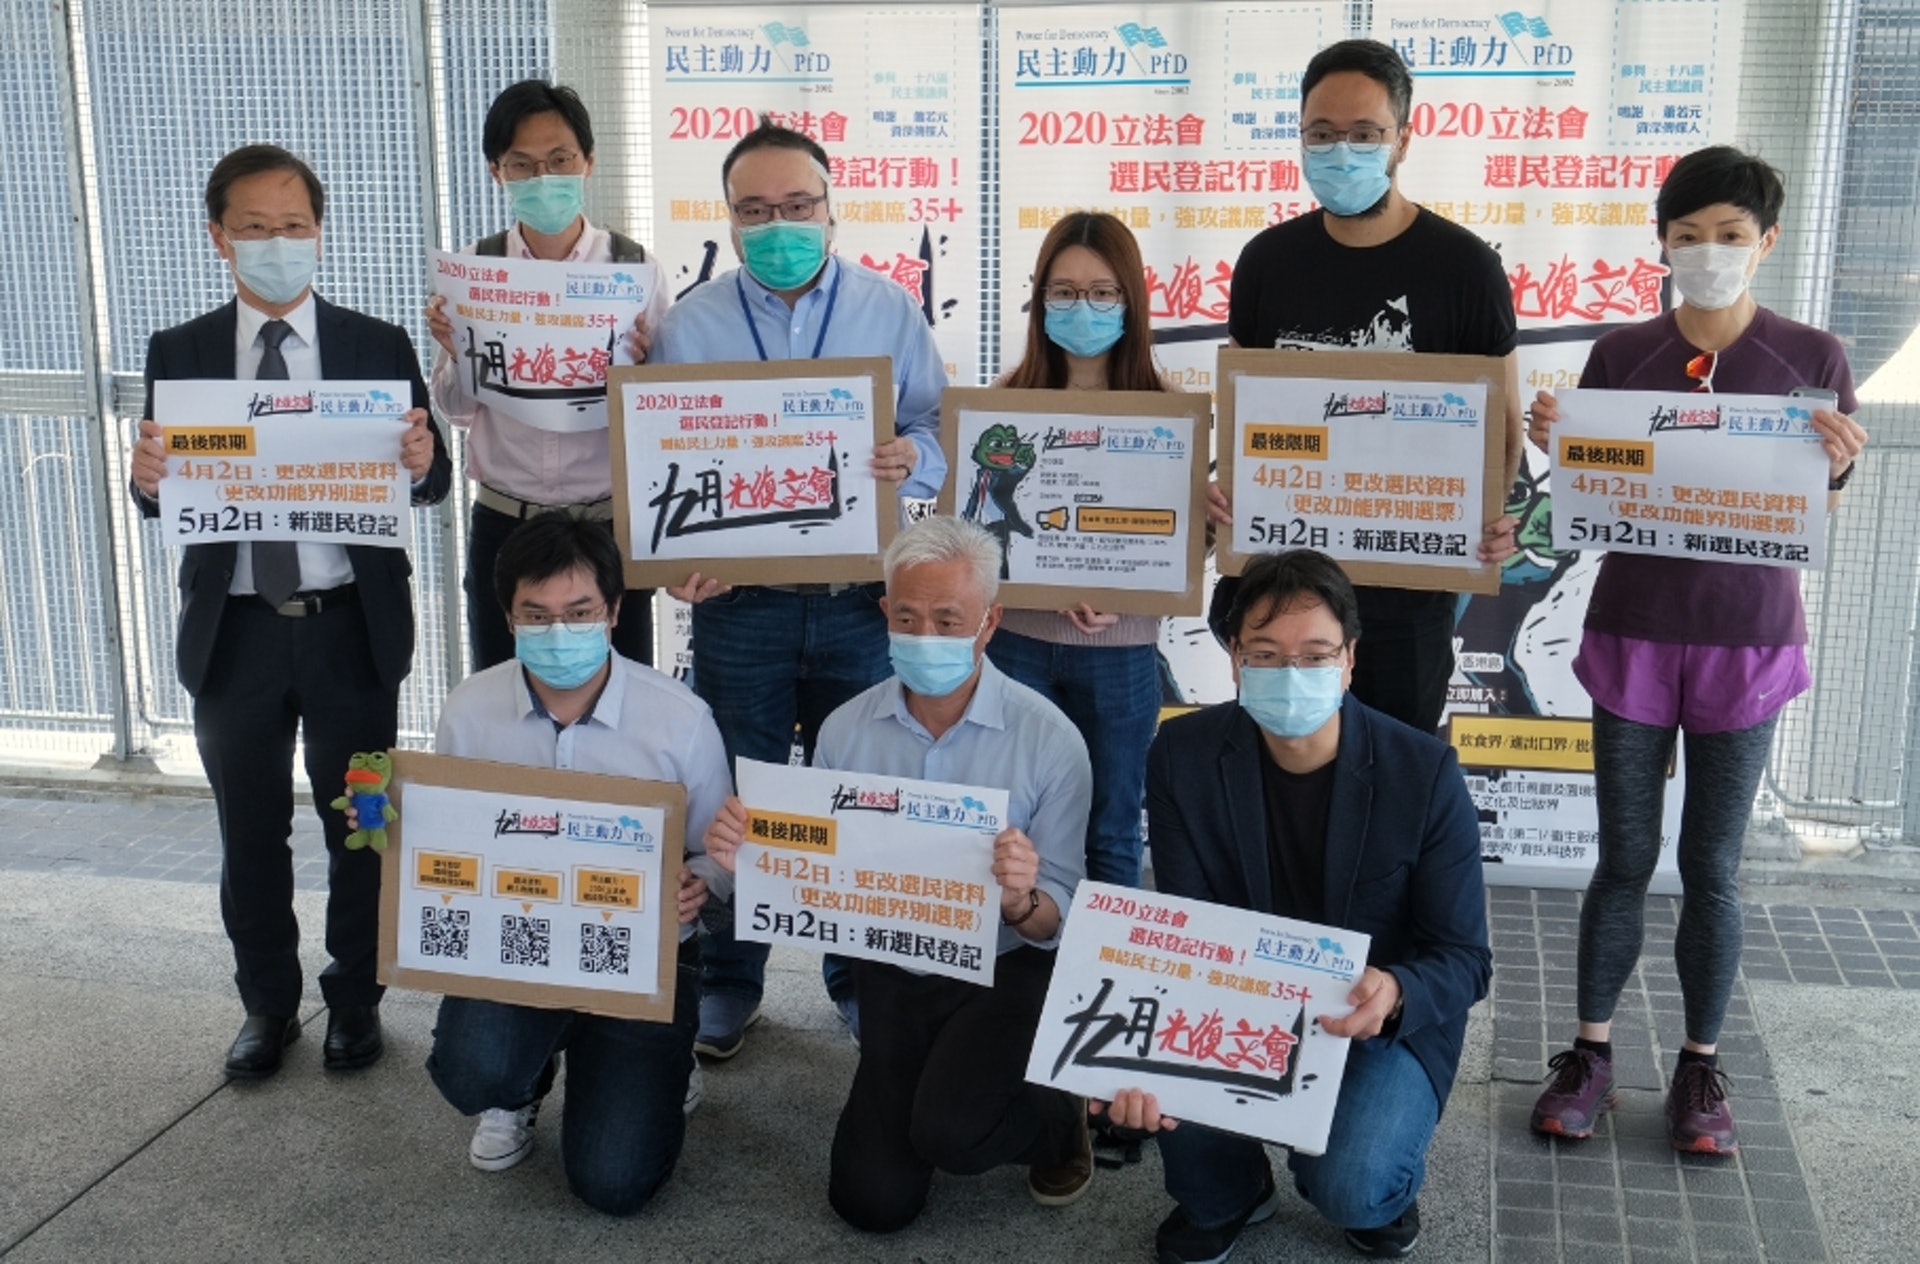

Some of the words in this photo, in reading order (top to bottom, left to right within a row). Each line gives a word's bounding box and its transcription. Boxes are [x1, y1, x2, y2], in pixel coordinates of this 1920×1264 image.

[1438, 18, 1490, 31] Democracy
[666, 45, 771, 74] 民主動力
[794, 52, 830, 72] PfD
[1016, 46, 1126, 77] 民主動力
[1151, 53, 1187, 74] PfD
[1392, 36, 1508, 67] 民主動力
[1533, 43, 1573, 65] PfD
[1018, 111, 1205, 146] 2020立法會
[1109, 160, 1300, 193] 選民登記行動
[836, 198, 963, 223] 攻議席35+
[437, 259, 508, 283] 2020立法會
[469, 287, 560, 307] 選民登記行動！
[566, 281, 617, 295] 民主動力
[320, 400, 375, 414] 民主動力
[636, 394, 723, 410] 2020立法會
[783, 397, 835, 413] 民主動力
[1393, 402, 1447, 417] 民主動力
[680, 414, 778, 430] 選民登記行動！
[1729, 416, 1790, 432] 民主動力
[172, 434, 247, 450] 最後限期
[1107, 435, 1158, 450] 民主動力
[1251, 432, 1320, 453] 最後限期
[1567, 445, 1644, 466] 最後限期
[177, 460, 398, 481] 4月2日：更改選民資料
[1253, 463, 1466, 498] 4月2日：更改選民資料
[215, 484, 397, 504] （更改功能界別選票）
[1571, 473, 1808, 515] 4月2日：更改選民資料
[1285, 494, 1465, 522] （更改功能界別選票）
[1608, 502, 1805, 535] （更改功能界別選票）
[178, 506, 398, 537] 5月2日：新選民登記
[1249, 517, 1467, 556] 5月2日：新選民登記
[1569, 517, 1809, 562] 5月2日：新選民登記
[1462, 655, 1501, 670] 香港島
[1460, 734, 1593, 752] 飲食界/進出口界/批
[906, 801, 966, 822] 民主動力
[567, 821, 623, 841] 民主動力
[752, 817, 828, 846] 最後限期
[755, 851, 986, 907] 4月2日：更改選民資料
[792, 886, 982, 932] （更改功能界別選票）
[1086, 893, 1189, 929] 2020立法會
[752, 904, 982, 971] 5月2日：新選民登記
[1129, 926, 1247, 966] 選民登記行動！
[1256, 937, 1320, 964] 民主動力
[1099, 945, 1312, 1001] 團結民主力量，強攻議席35+
